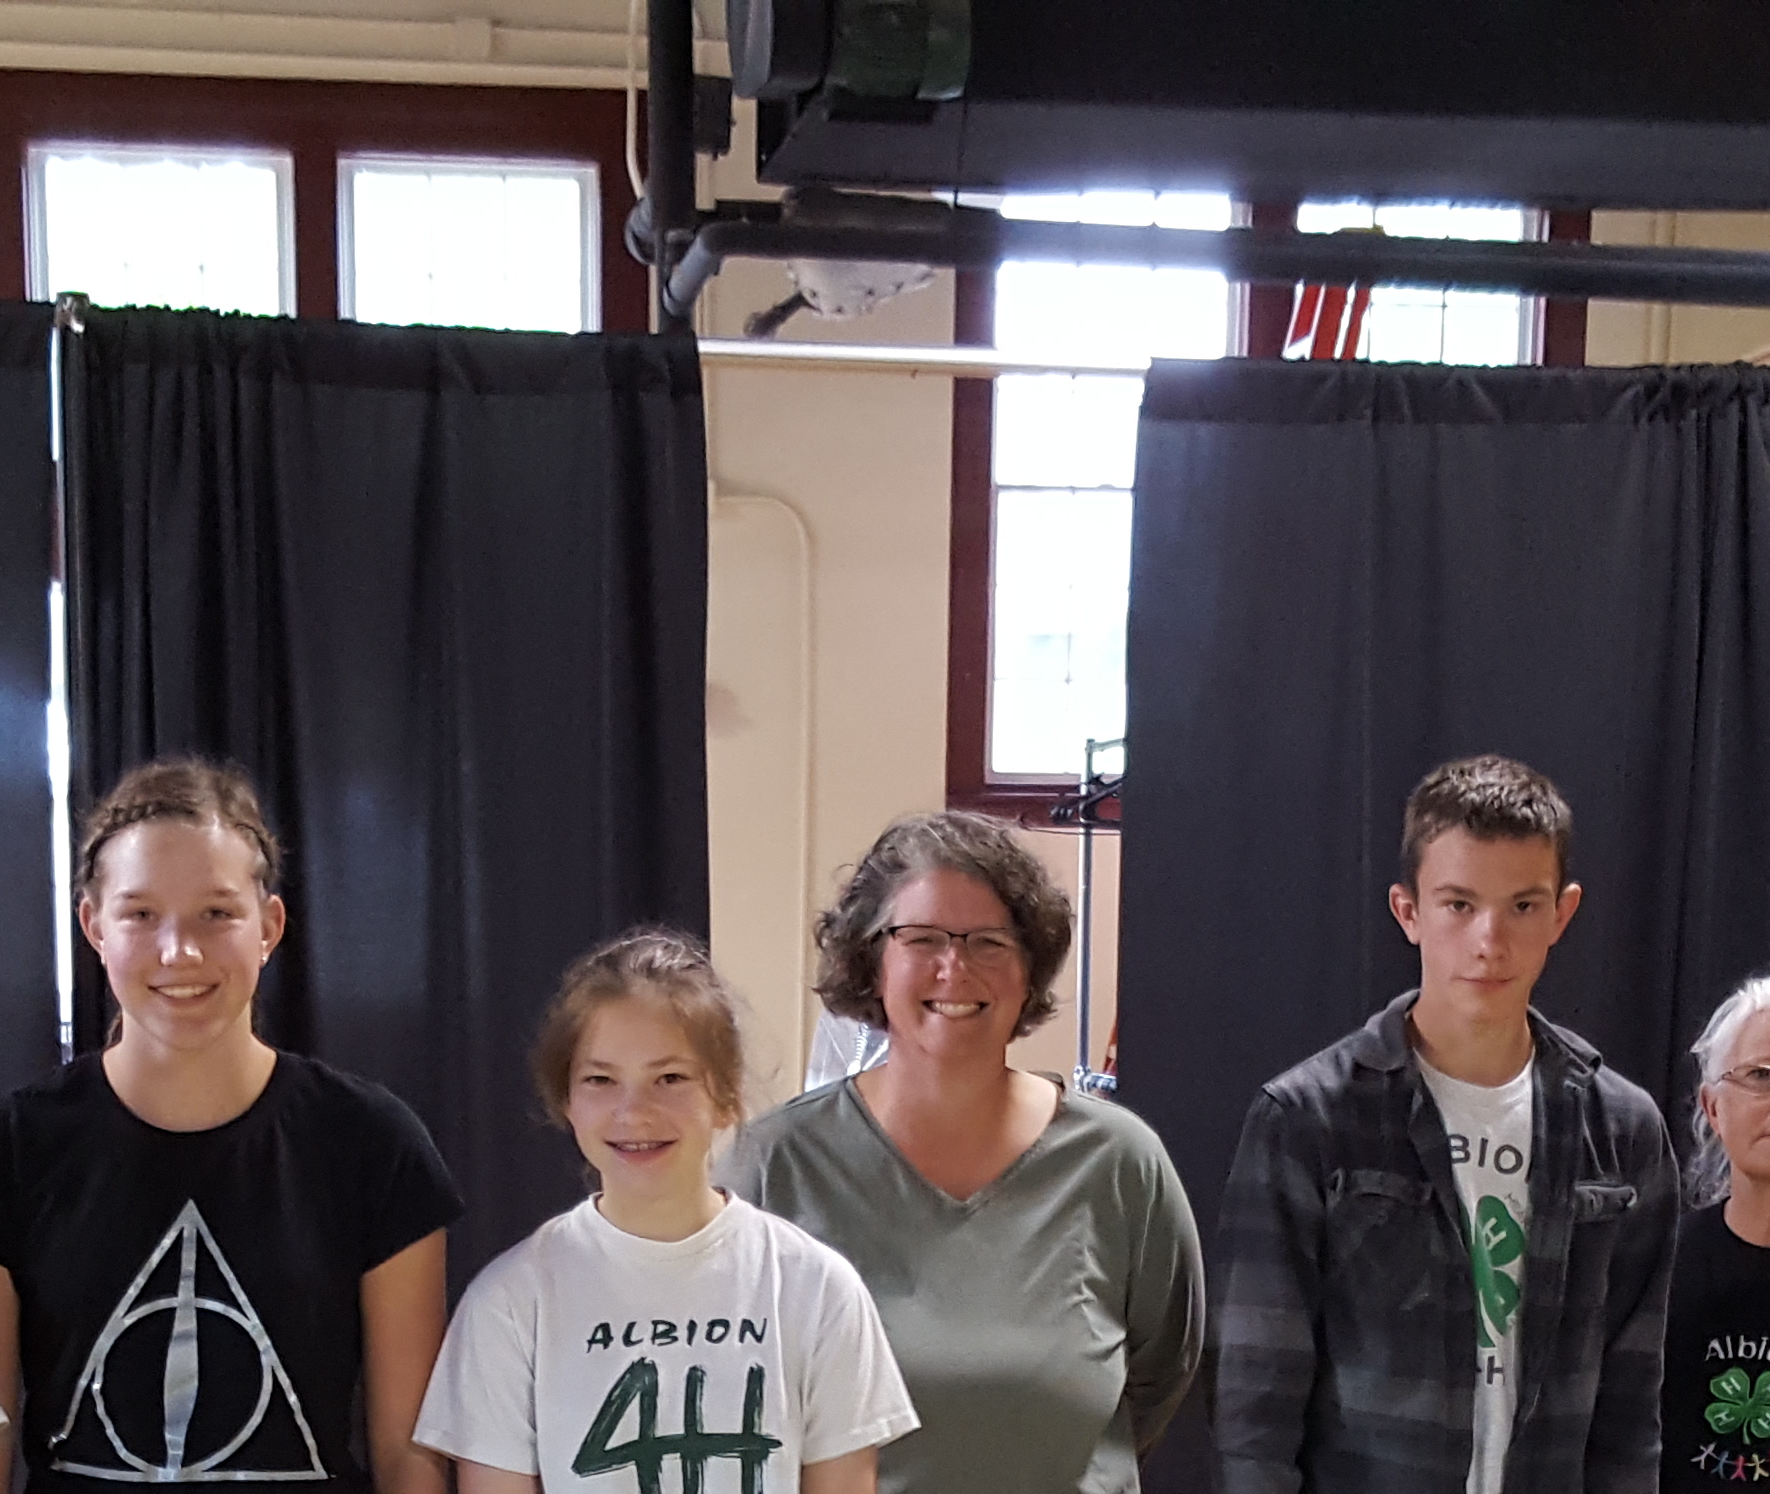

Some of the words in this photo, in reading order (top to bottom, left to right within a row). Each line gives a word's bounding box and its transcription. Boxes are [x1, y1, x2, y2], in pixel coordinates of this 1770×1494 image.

[1447, 1133, 1529, 1183] BIO
[587, 1318, 767, 1354] ALBION
[1720, 1377, 1741, 1395] H
[1713, 1411, 1735, 1427] H
